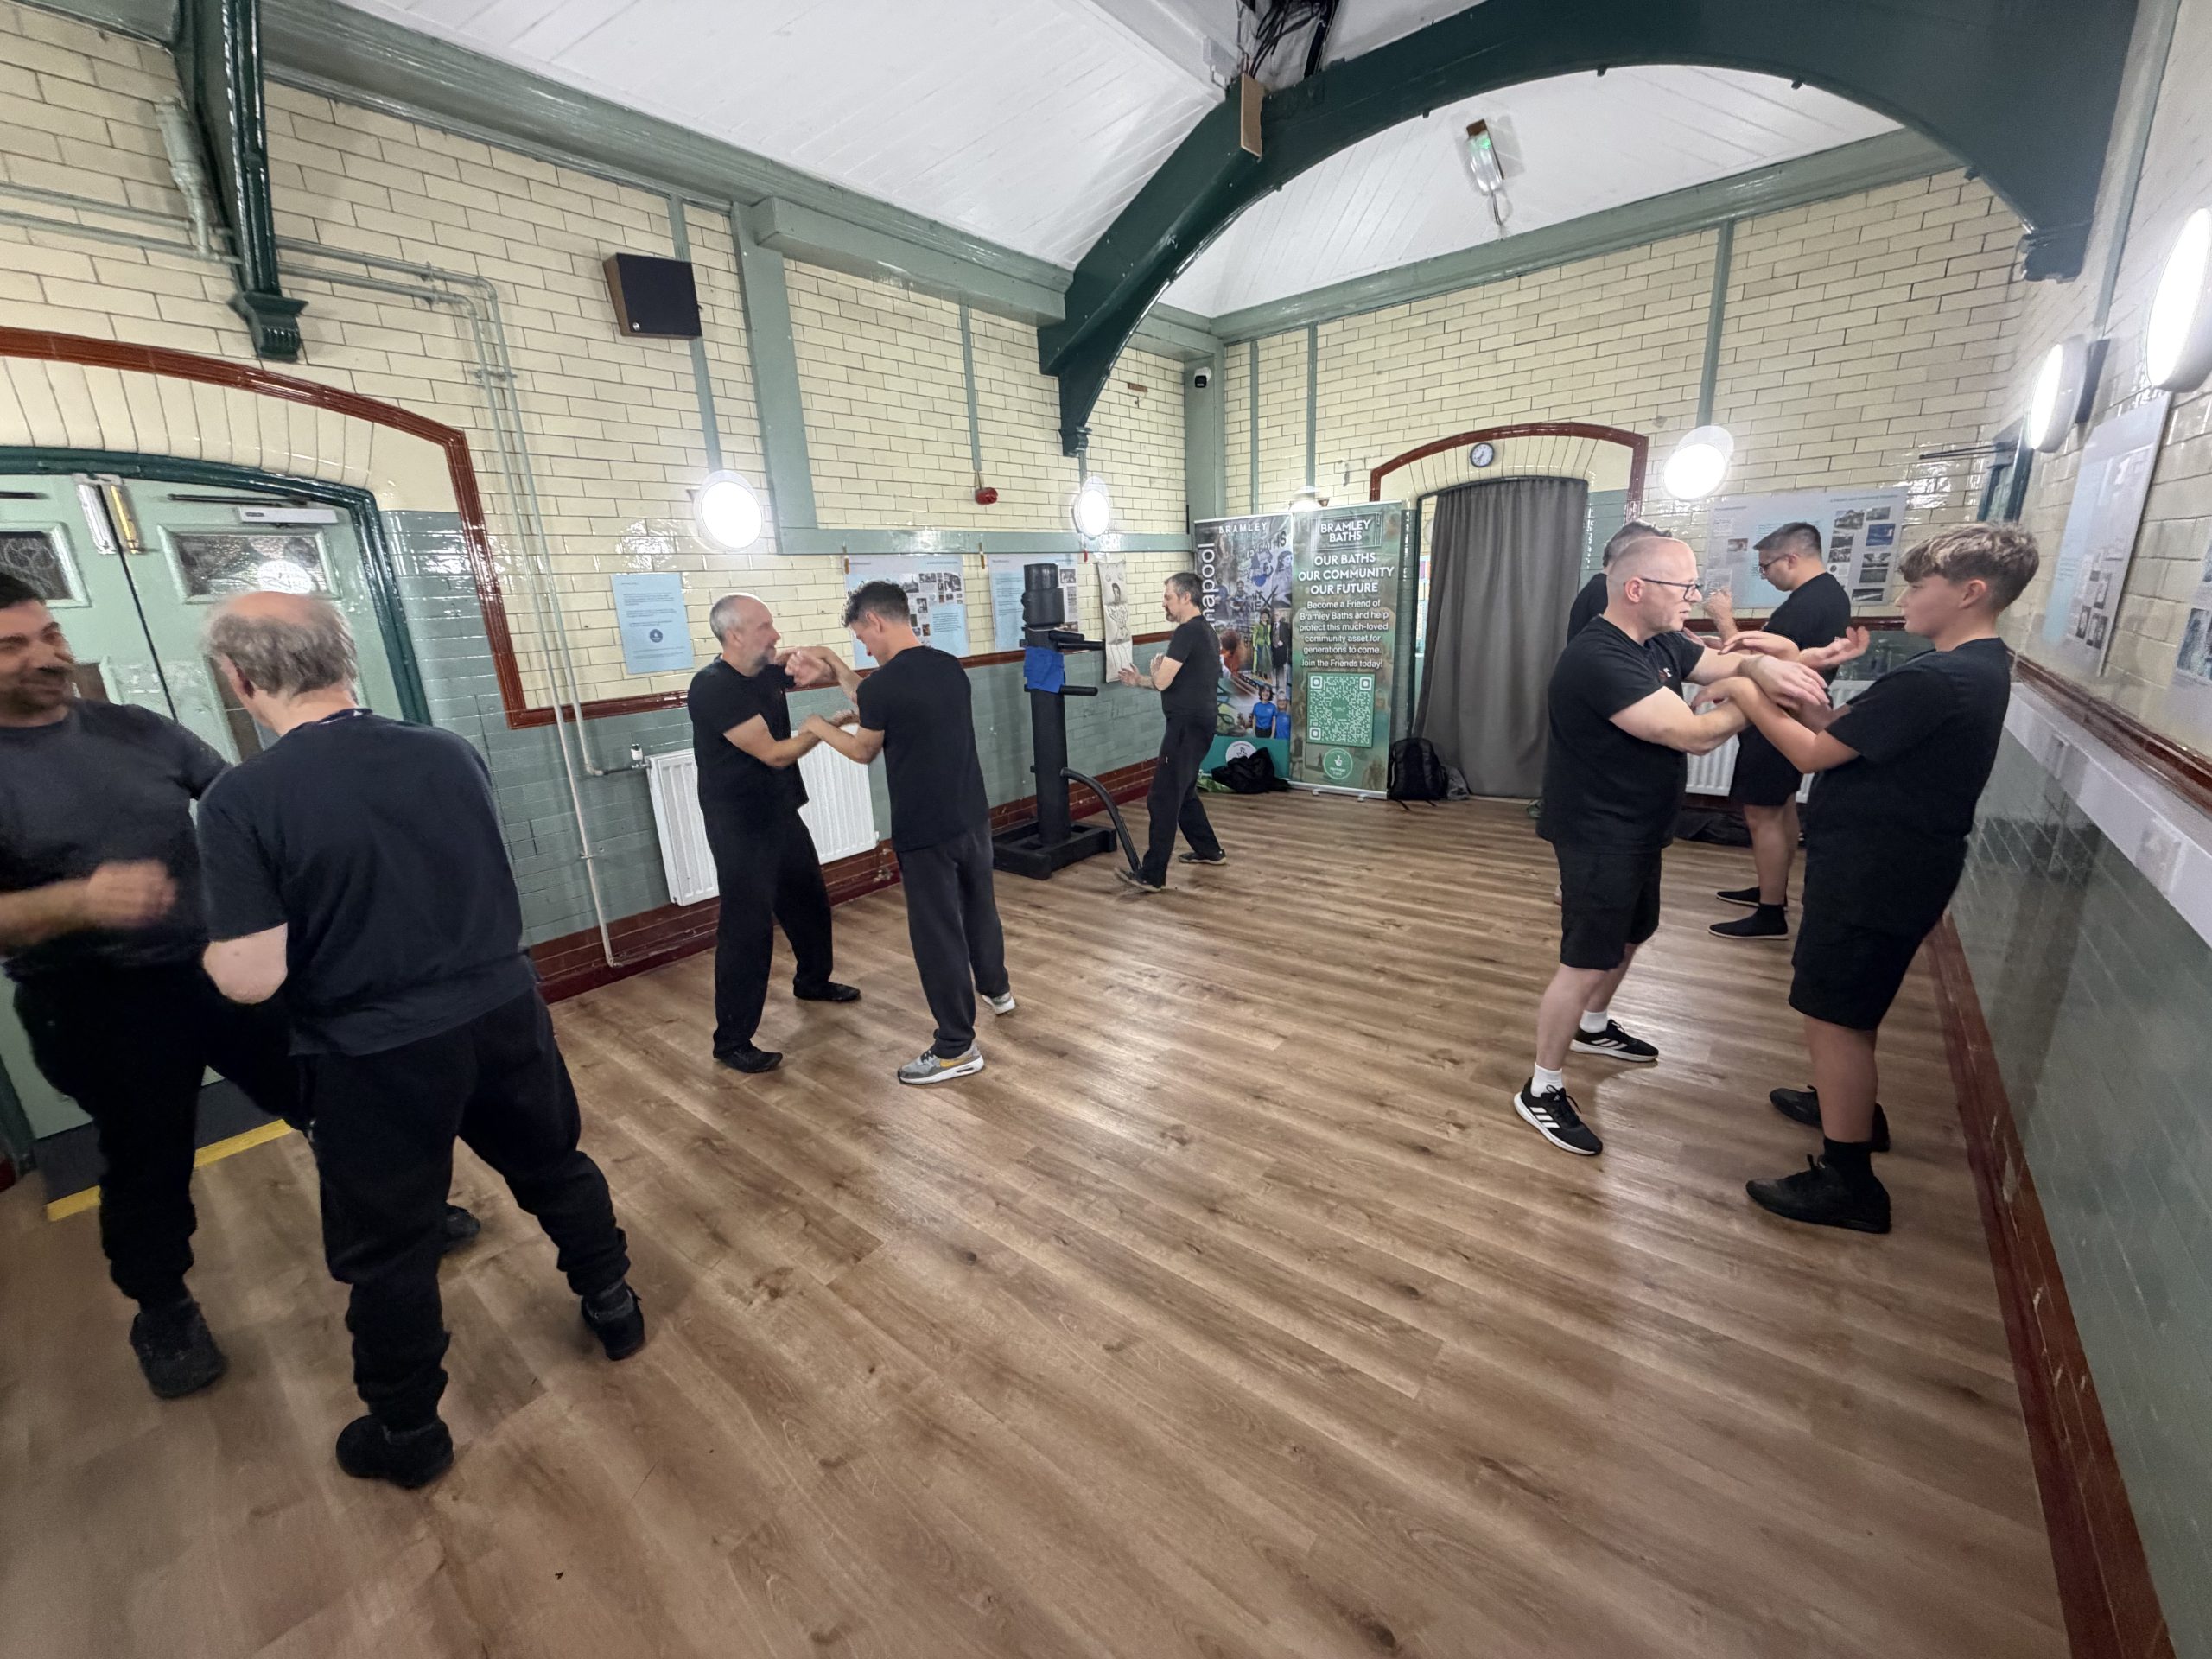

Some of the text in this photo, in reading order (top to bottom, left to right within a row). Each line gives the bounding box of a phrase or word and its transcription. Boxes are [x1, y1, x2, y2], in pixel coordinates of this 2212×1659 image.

[1218, 522, 1267, 534] BRAMLEY
[1320, 518, 1372, 533] BRAMLEY
[1329, 531, 1363, 543] BATHS
[1314, 552, 1376, 566] OUR BATHS
[1298, 566, 1395, 582] OUR COMMUNITY
[1310, 582, 1378, 594] OUR FUTURE
[1306, 601, 1338, 609] Become
[1300, 612, 1330, 621] Bramley
[1370, 611, 1389, 620] help
[1299, 624, 1325, 632] protect
[1342, 622, 1389, 631] much-loved
[1305, 635, 1346, 644] community
[1347, 634, 1370, 643] asset
[1303, 646, 1348, 655] generations
[1359, 659, 1383, 669] today!
